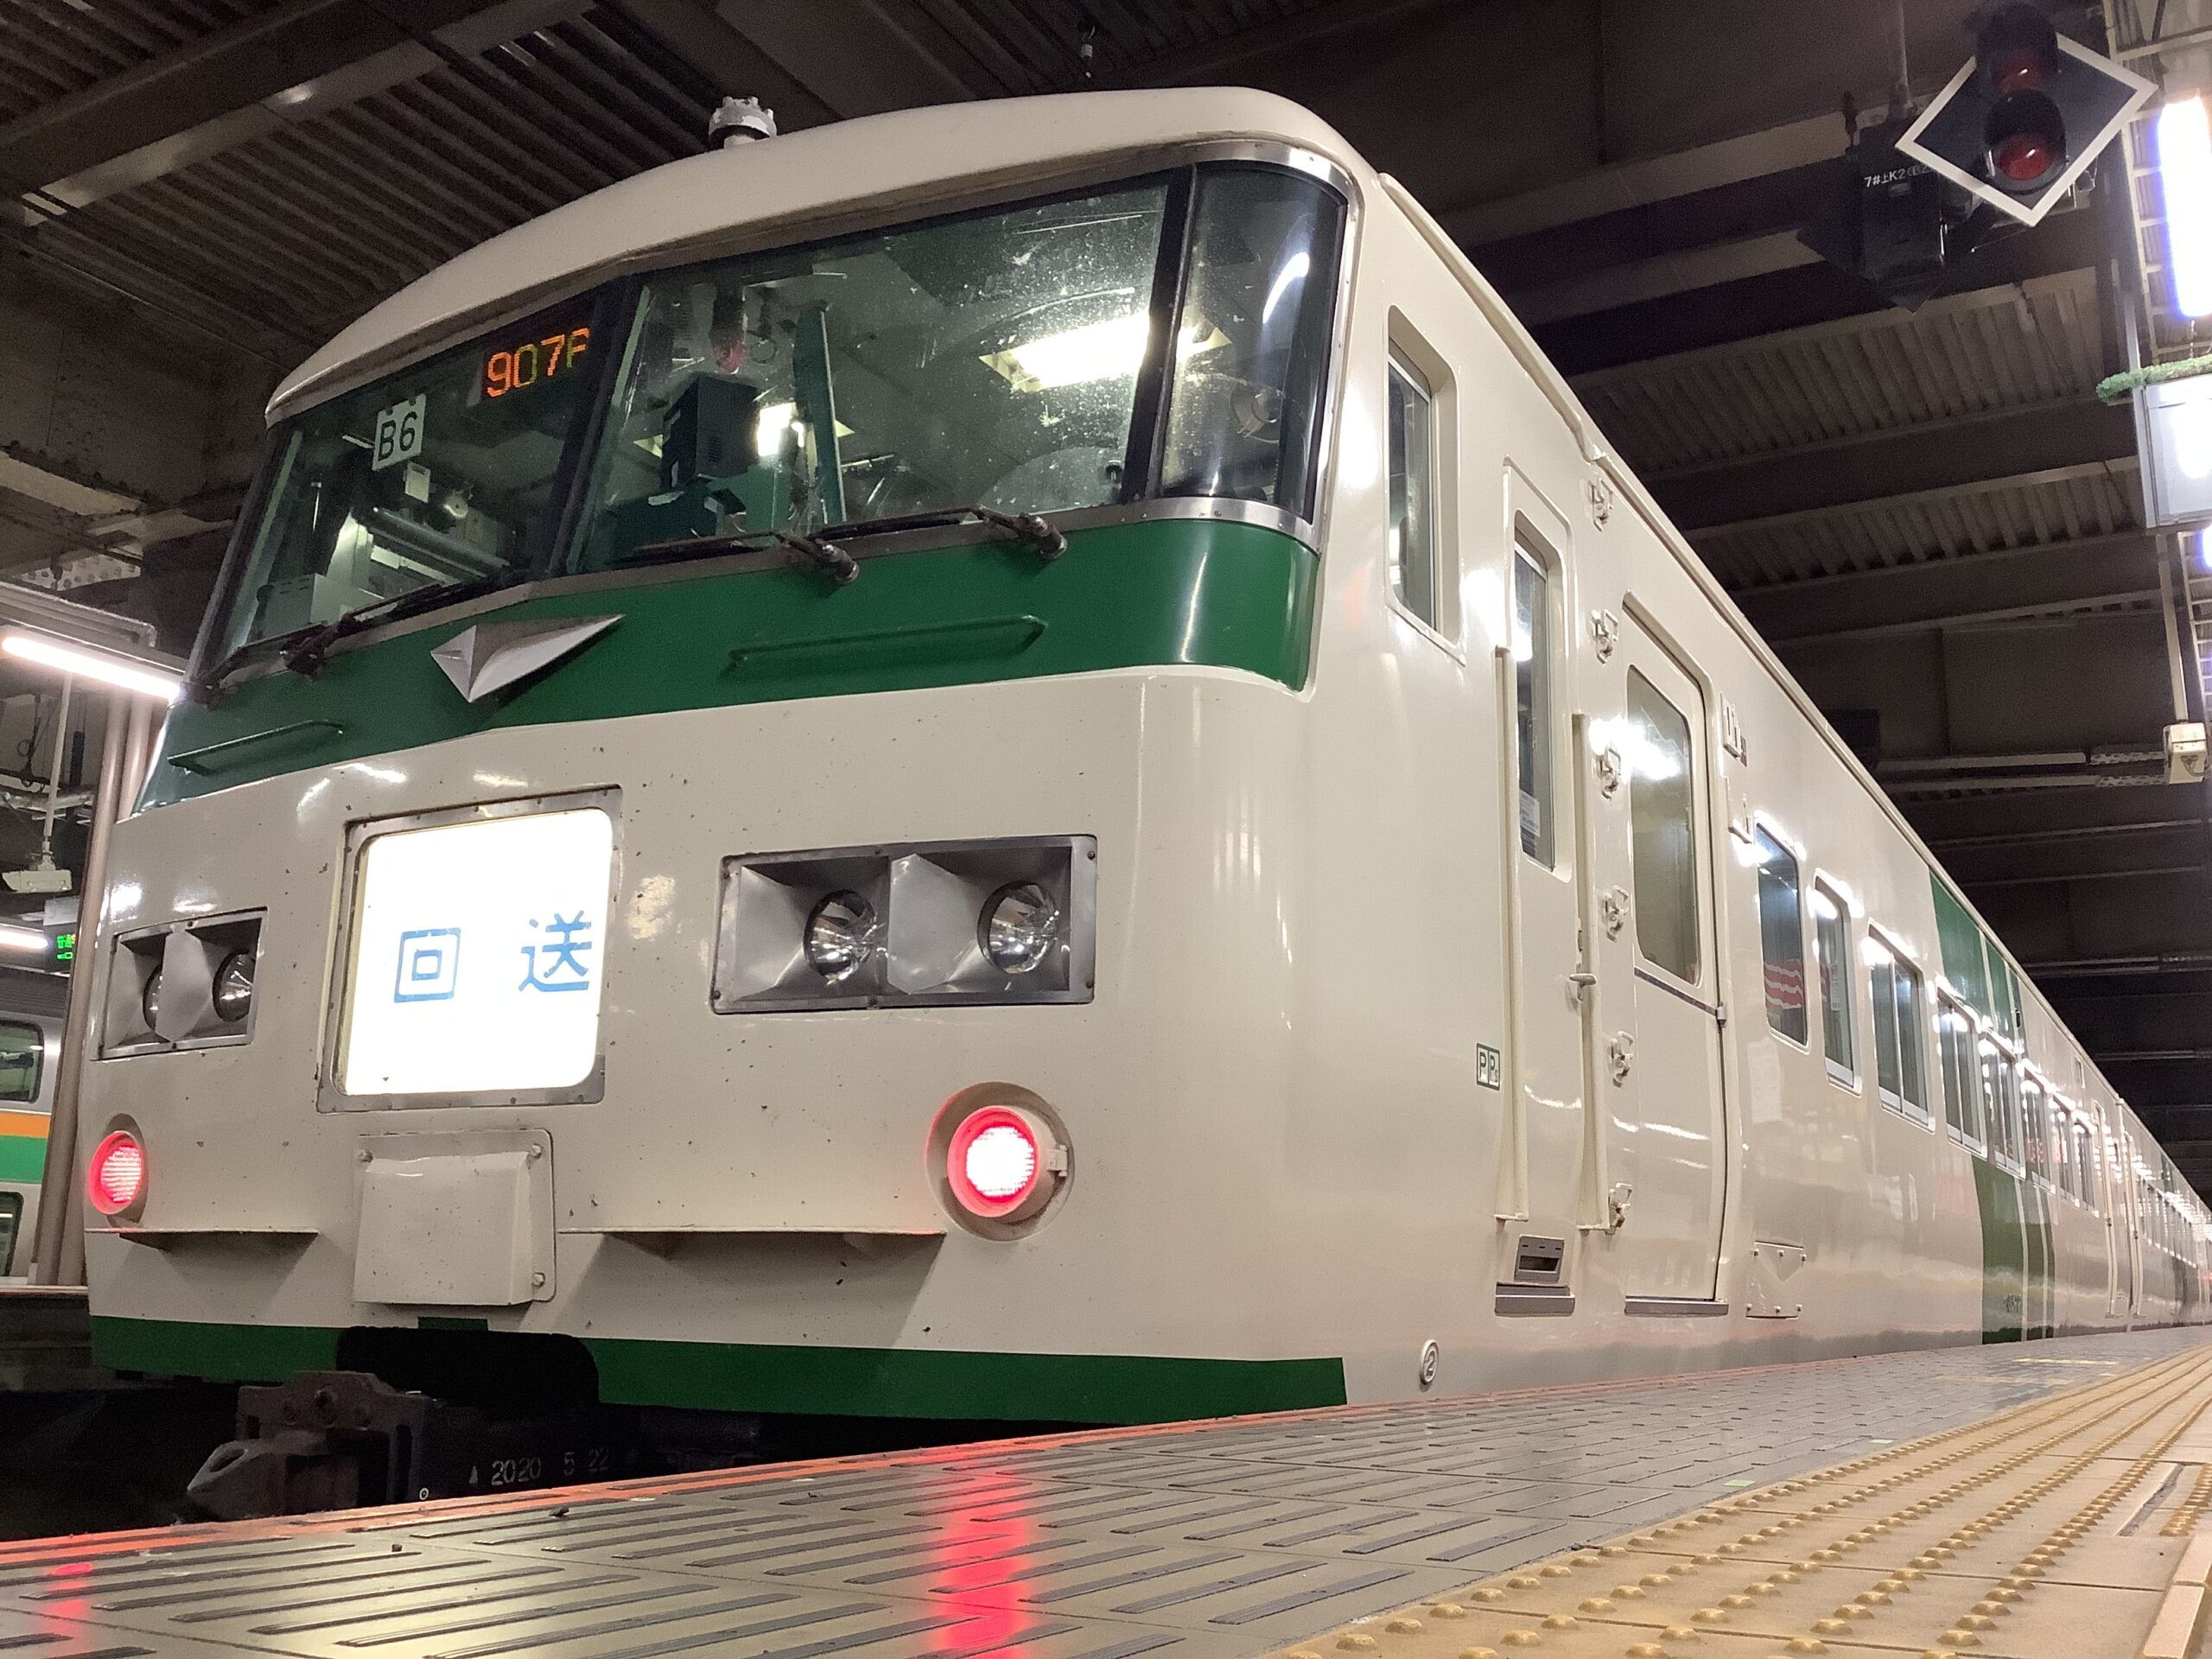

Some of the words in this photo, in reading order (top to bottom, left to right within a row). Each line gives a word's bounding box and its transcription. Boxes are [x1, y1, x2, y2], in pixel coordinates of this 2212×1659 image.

[486, 327, 589, 397] 907F
[378, 411, 417, 461] B6
[393, 910, 593, 1003] 回送
[491, 1457, 542, 1486] 2020
[563, 1452, 575, 1477] 5
